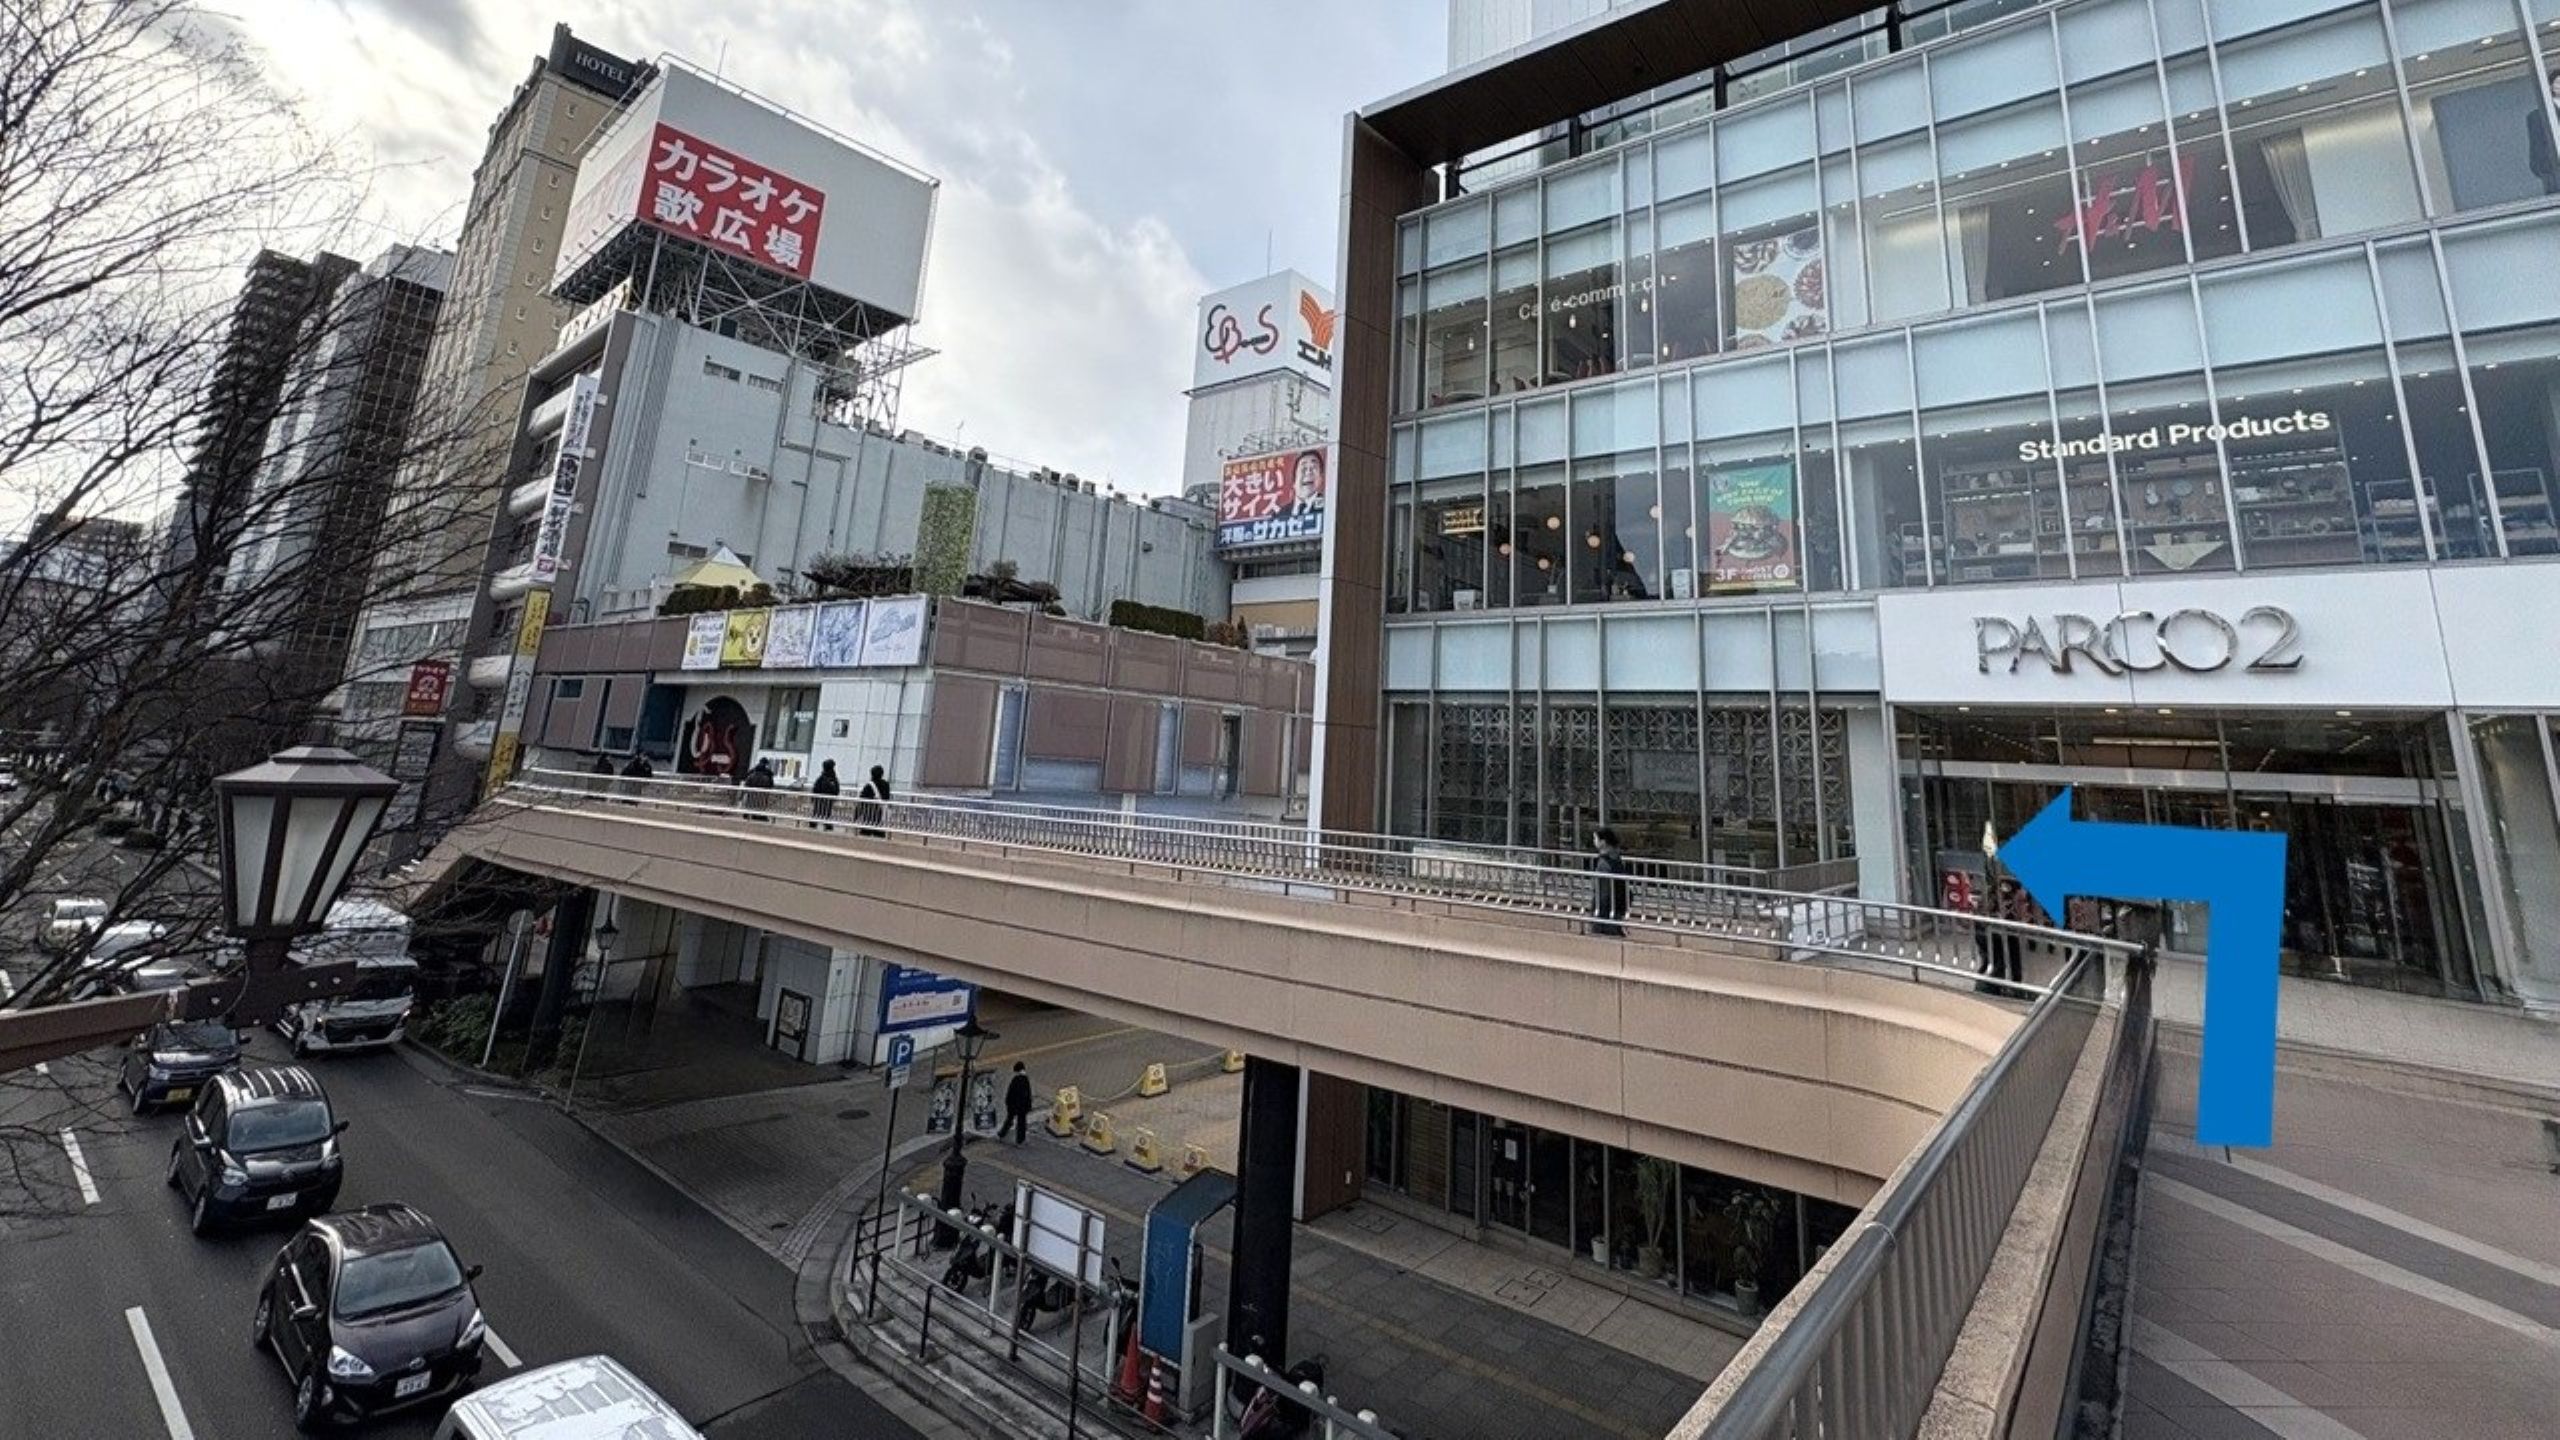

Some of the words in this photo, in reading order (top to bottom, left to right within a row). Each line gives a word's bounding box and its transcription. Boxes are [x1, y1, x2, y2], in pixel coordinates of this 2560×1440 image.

[574, 51, 627, 84] HOTEL
[654, 138, 819, 225] カラオケ
[653, 180, 803, 271] 歌広場
[2018, 427, 2160, 462] Standard
[2168, 409, 2331, 446] Products
[1223, 468, 1285, 498] 大きい
[1223, 491, 1283, 520] サイズ
[898, 1041, 910, 1063] P
